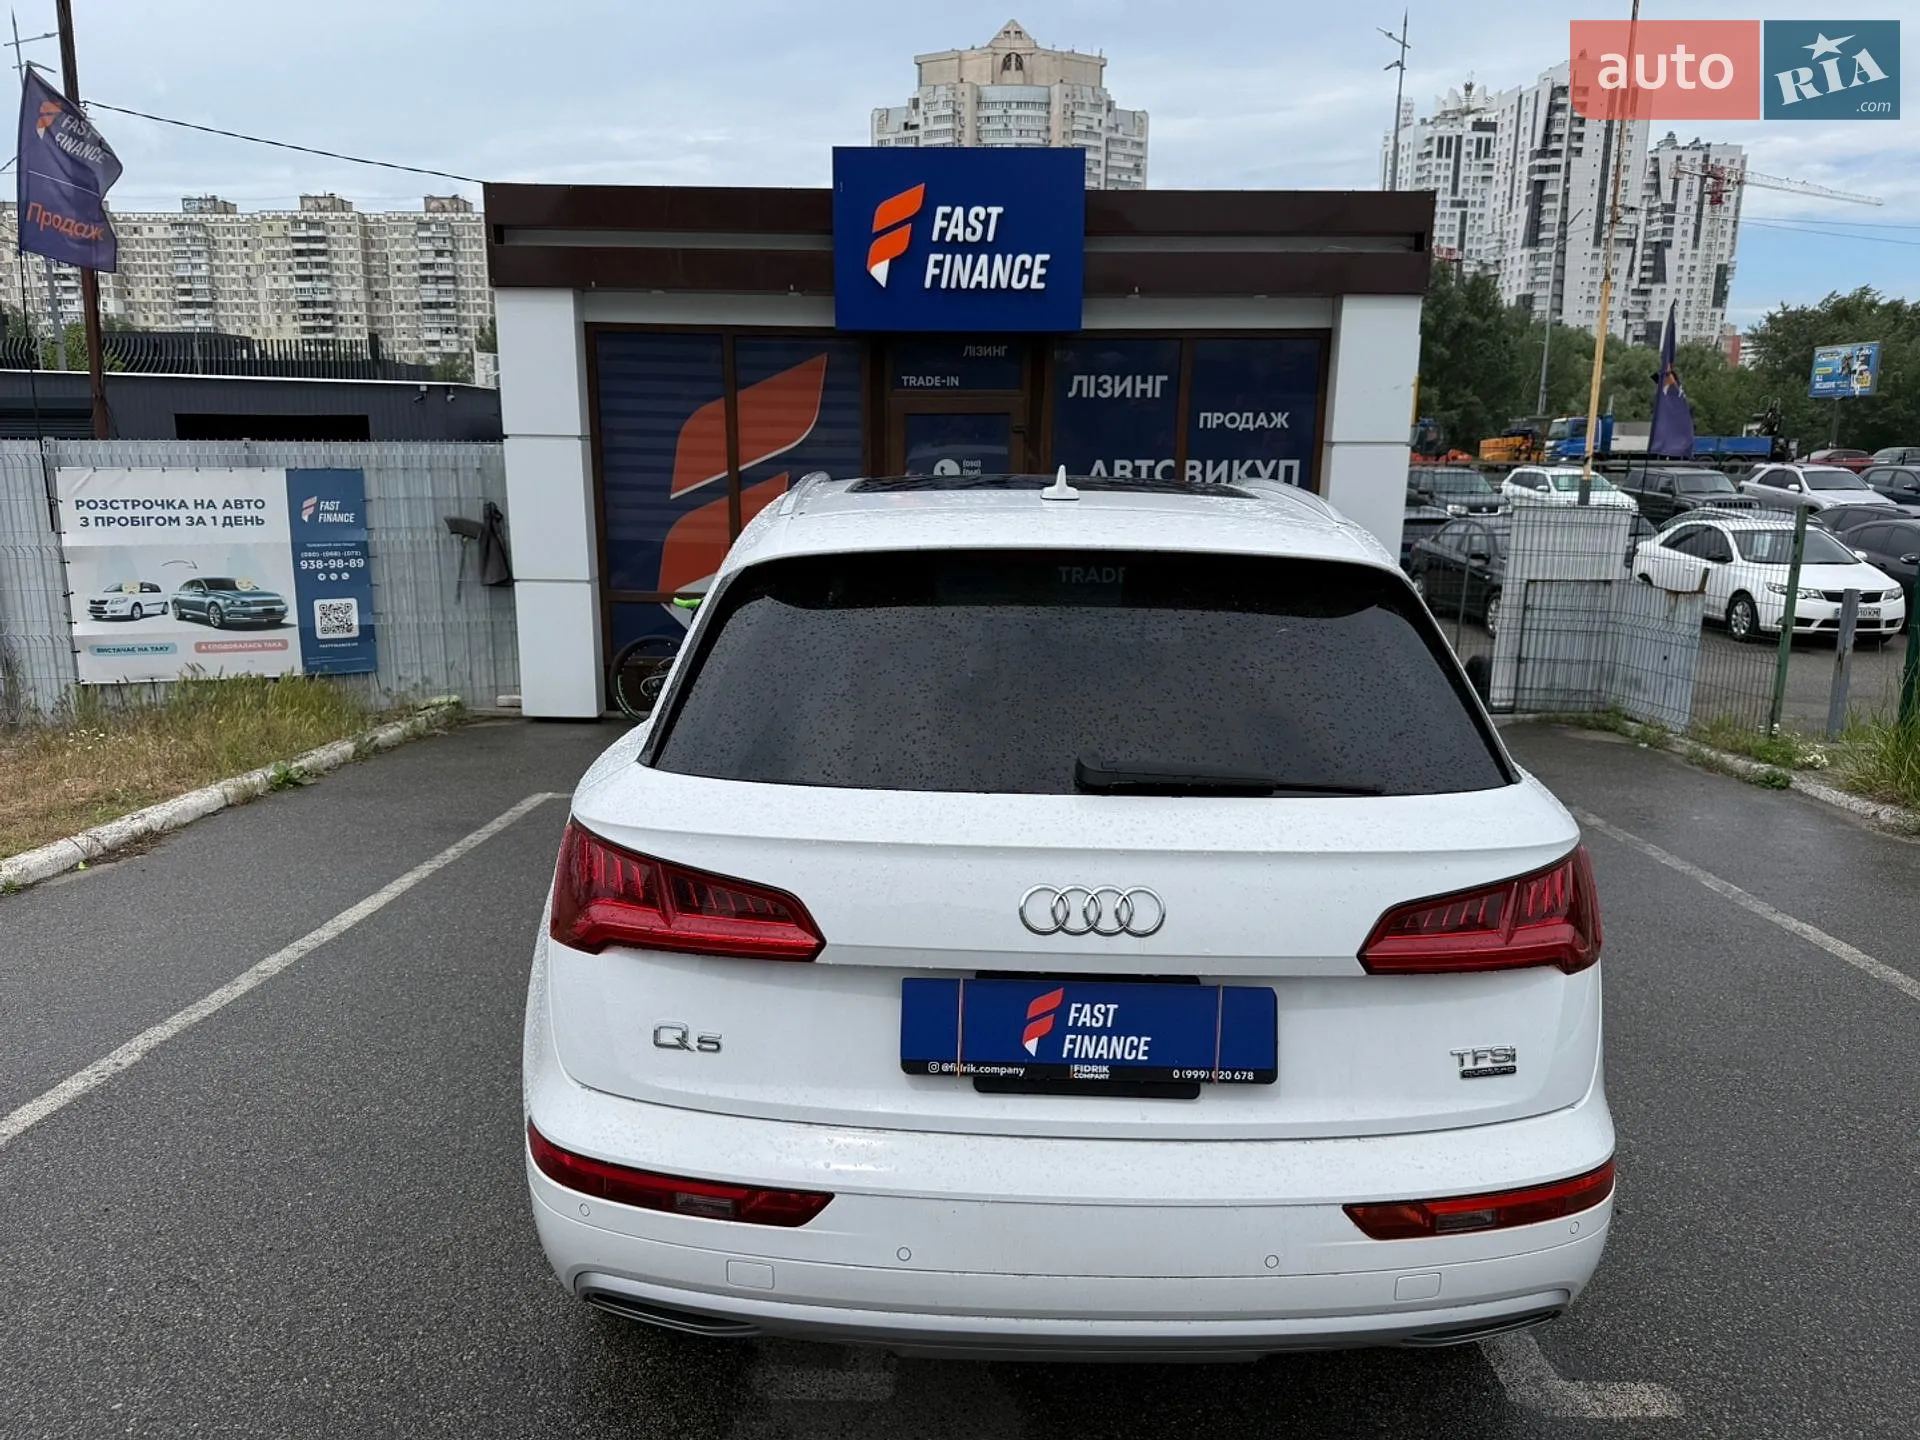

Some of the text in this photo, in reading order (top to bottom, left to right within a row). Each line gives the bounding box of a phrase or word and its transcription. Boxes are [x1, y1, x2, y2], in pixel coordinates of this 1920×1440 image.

[60, 114, 102, 140] FAST
[26, 201, 105, 241] Продаж
[931, 206, 1004, 242] FAST
[924, 253, 1050, 289] FINANCE
[901, 375, 959, 387] TRADE-IN
[1067, 375, 1168, 399] ЛІЗИНГ
[1199, 412, 1290, 431] ПРОДАЖ
[75, 498, 266, 511] РОЗСТРОЧКА НА АВТО
[319, 501, 340, 512] FAST
[94, 515, 181, 527] ПРОБІГОМ
[222, 515, 265, 528] ДЕНЬ
[318, 512, 355, 524] FINANCE
[299, 558, 365, 570] 938-98-89
[1067, 1003, 1119, 1028] FAST
[653, 1022, 723, 1053] Q5
[1062, 1034, 1152, 1060] FINANCE
[1073, 1064, 1110, 1073] FIDRIK
[1172, 1069, 1180, 1079] 0
[1181, 1069, 1210, 1080] (999)
[1233, 1071, 1254, 1080] 678
